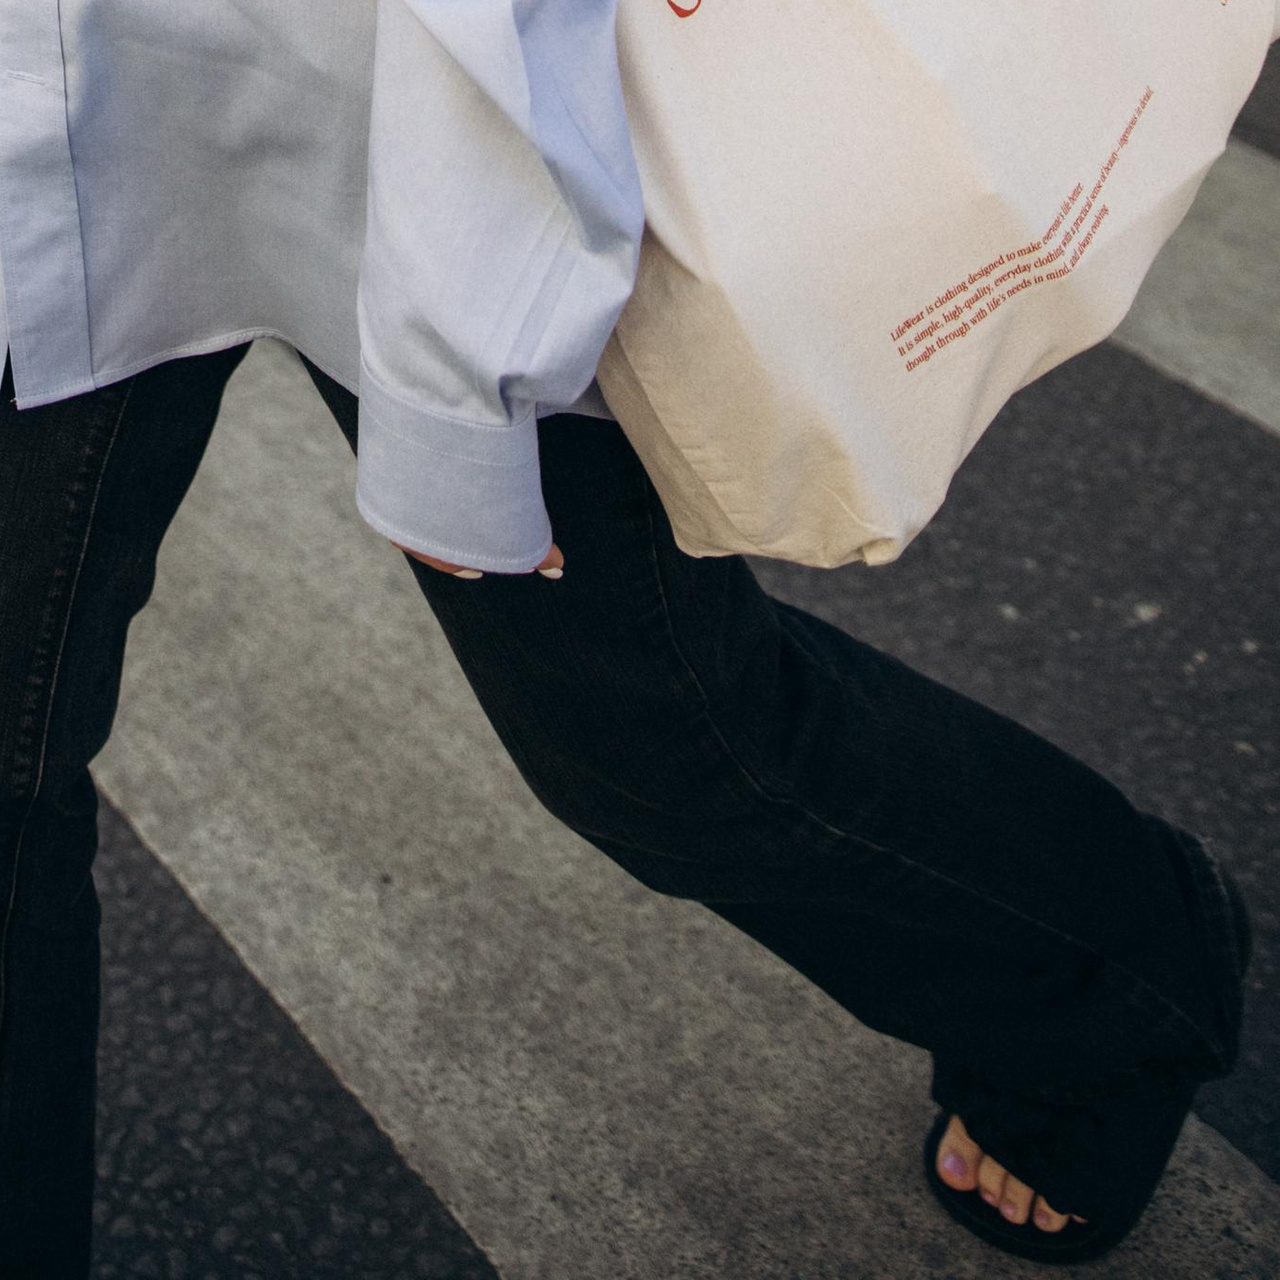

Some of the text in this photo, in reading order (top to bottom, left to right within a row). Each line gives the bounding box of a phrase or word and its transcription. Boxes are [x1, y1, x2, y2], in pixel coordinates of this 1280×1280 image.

[890, 310, 925, 342] LifeWear
[926, 305, 934, 315] is
[934, 281, 969, 309] clothing
[968, 255, 1006, 285] designed
[1006, 252, 1016, 262] to
[1017, 240, 1042, 257] make
[898, 346, 907, 357] It
[906, 341, 915, 351] is
[994, 262, 1032, 288] everyday
[1034, 245, 1065, 268] clothing
[905, 344, 937, 372] thought
[936, 321, 972, 349] through
[970, 307, 988, 326] with
[1007, 277, 1032, 298] needs
[1034, 274, 1044, 284] in
